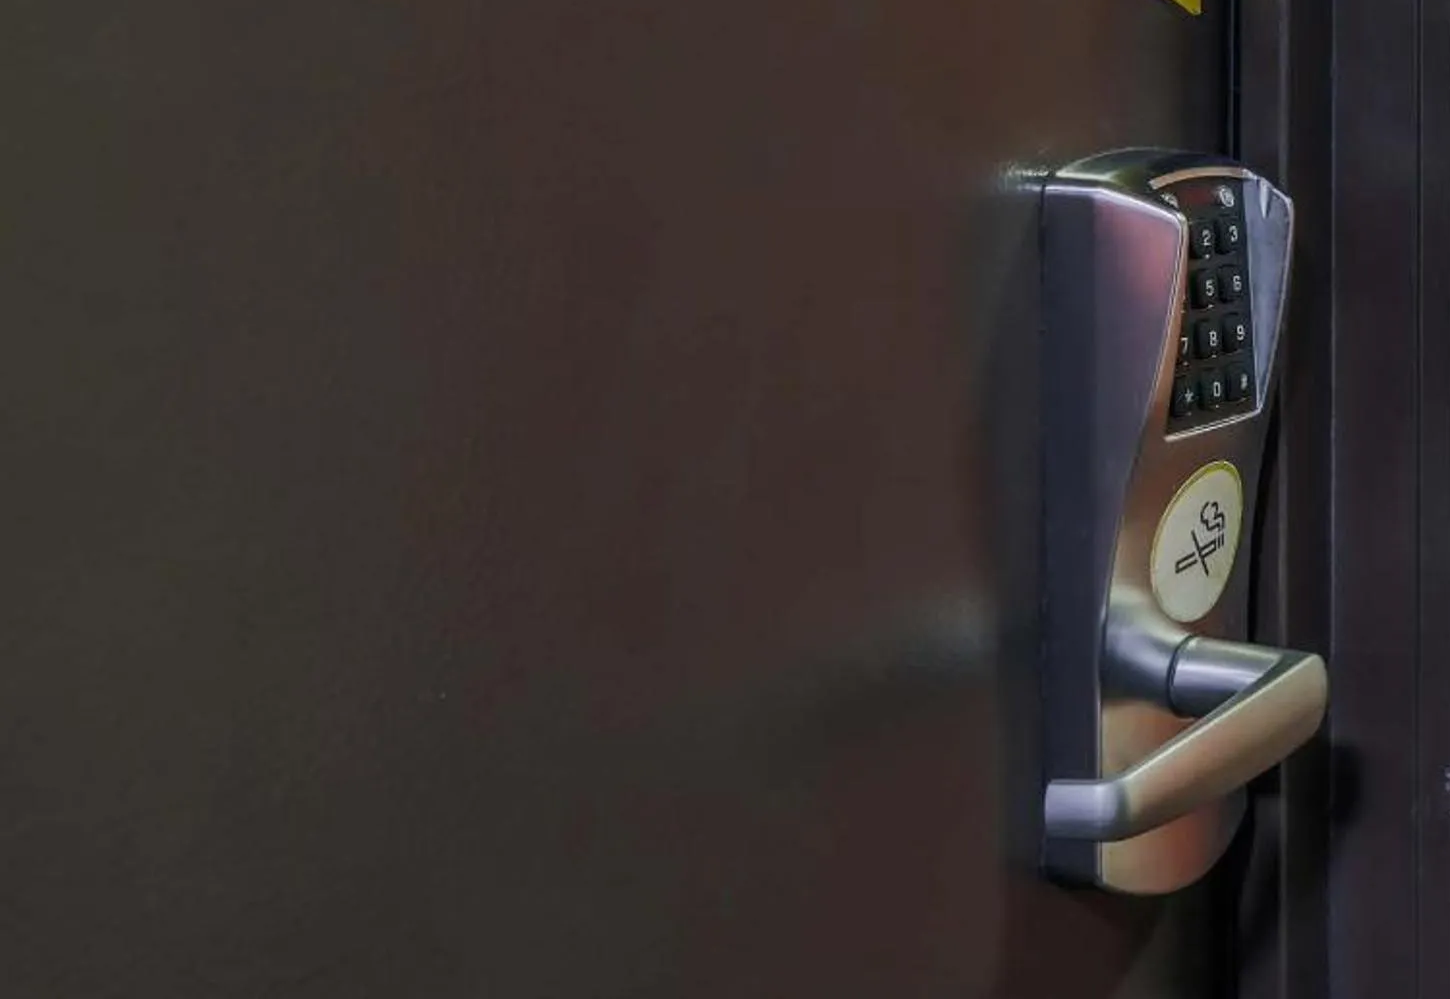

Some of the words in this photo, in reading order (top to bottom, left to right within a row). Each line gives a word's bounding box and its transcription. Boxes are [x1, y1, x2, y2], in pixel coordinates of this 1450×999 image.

[1202, 229, 1212, 246] 2
[1229, 225, 1238, 242] 3
[1206, 280, 1215, 296] 5
[1233, 275, 1242, 292] 6
[1181, 337, 1188, 355] 7
[1208, 330, 1218, 347] 8
[1236, 324, 1245, 341] 9
[1213, 381, 1221, 397] 0
